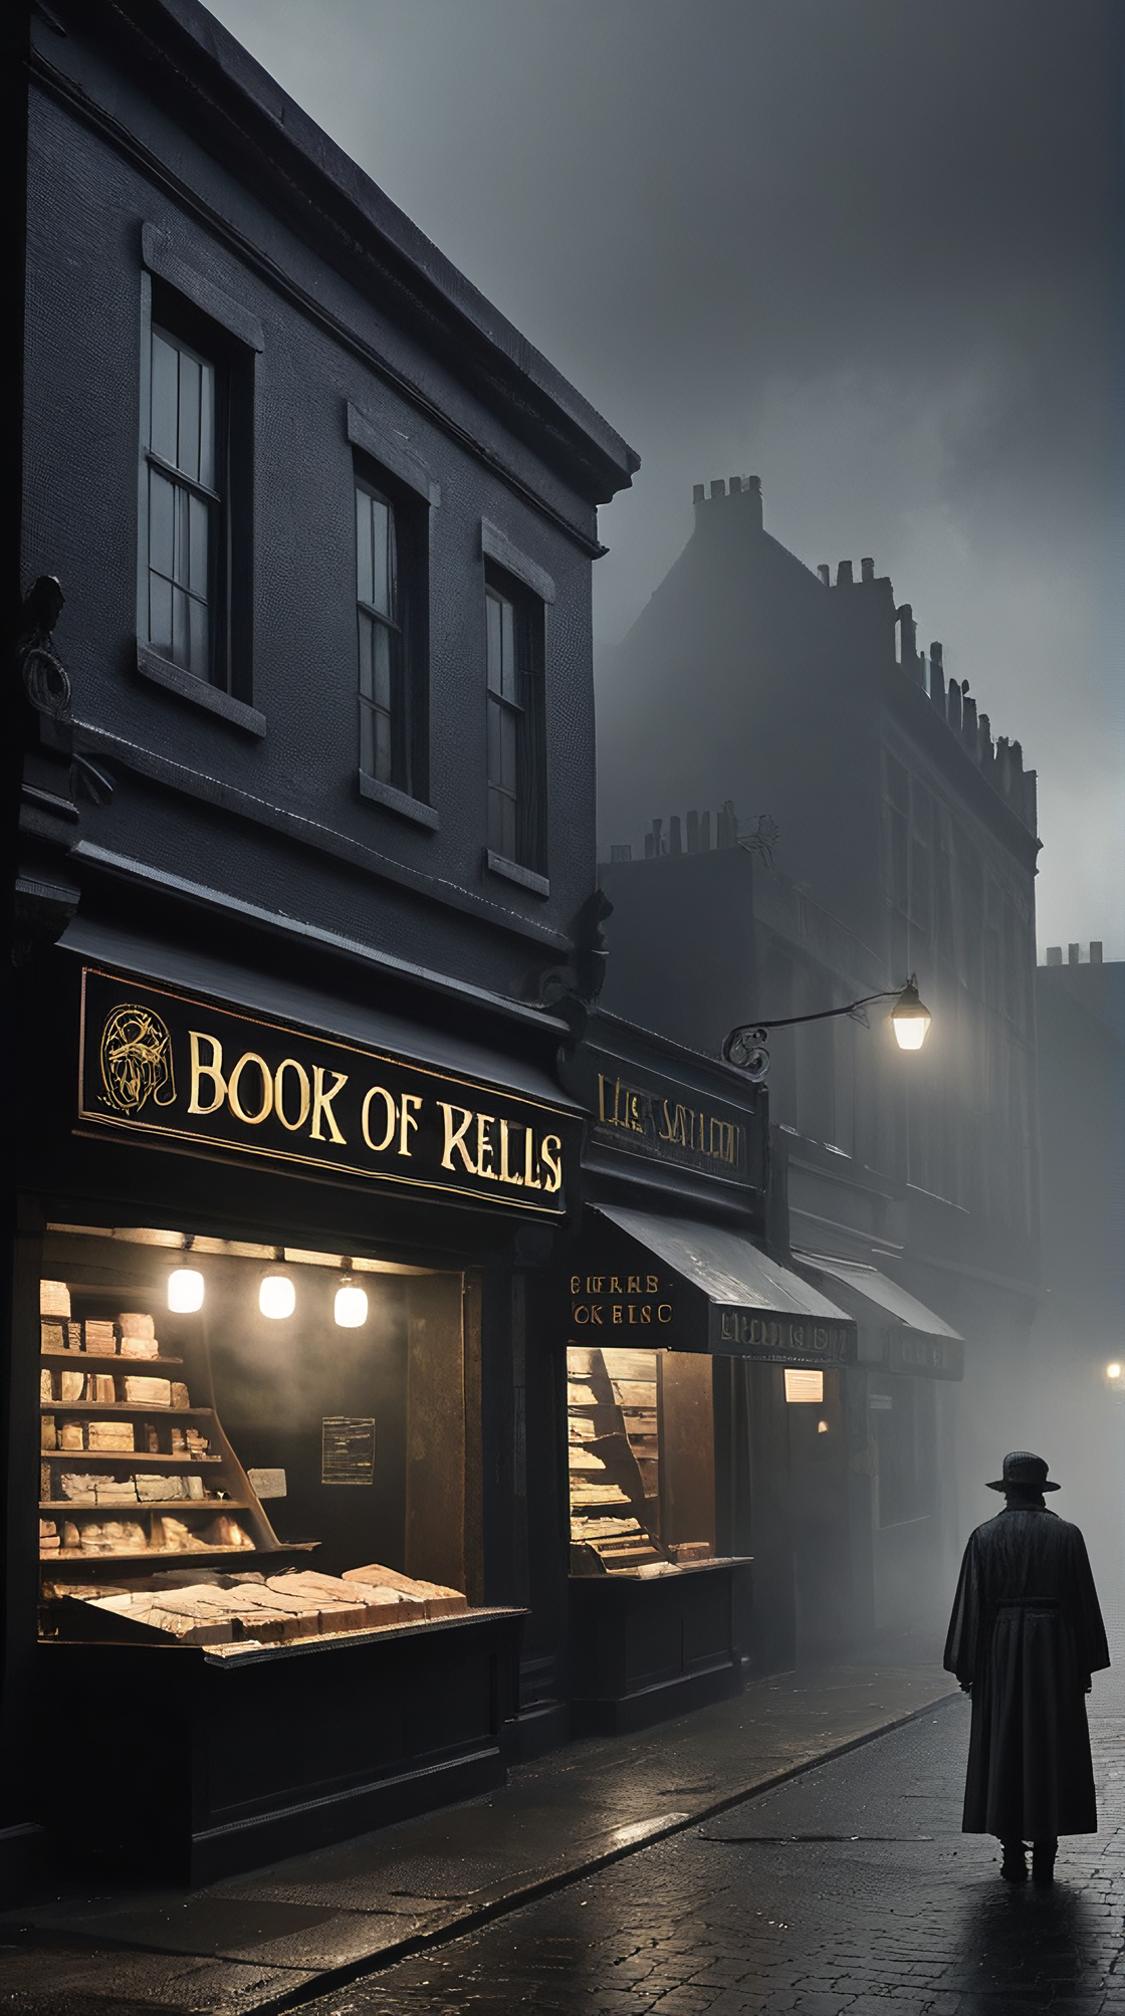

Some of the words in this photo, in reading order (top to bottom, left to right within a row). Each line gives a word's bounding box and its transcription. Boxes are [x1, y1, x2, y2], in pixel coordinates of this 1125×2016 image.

[187, 1030, 349, 1144] BOOK
[362, 1086, 423, 1156] OF
[436, 1100, 562, 1193] KELLS
